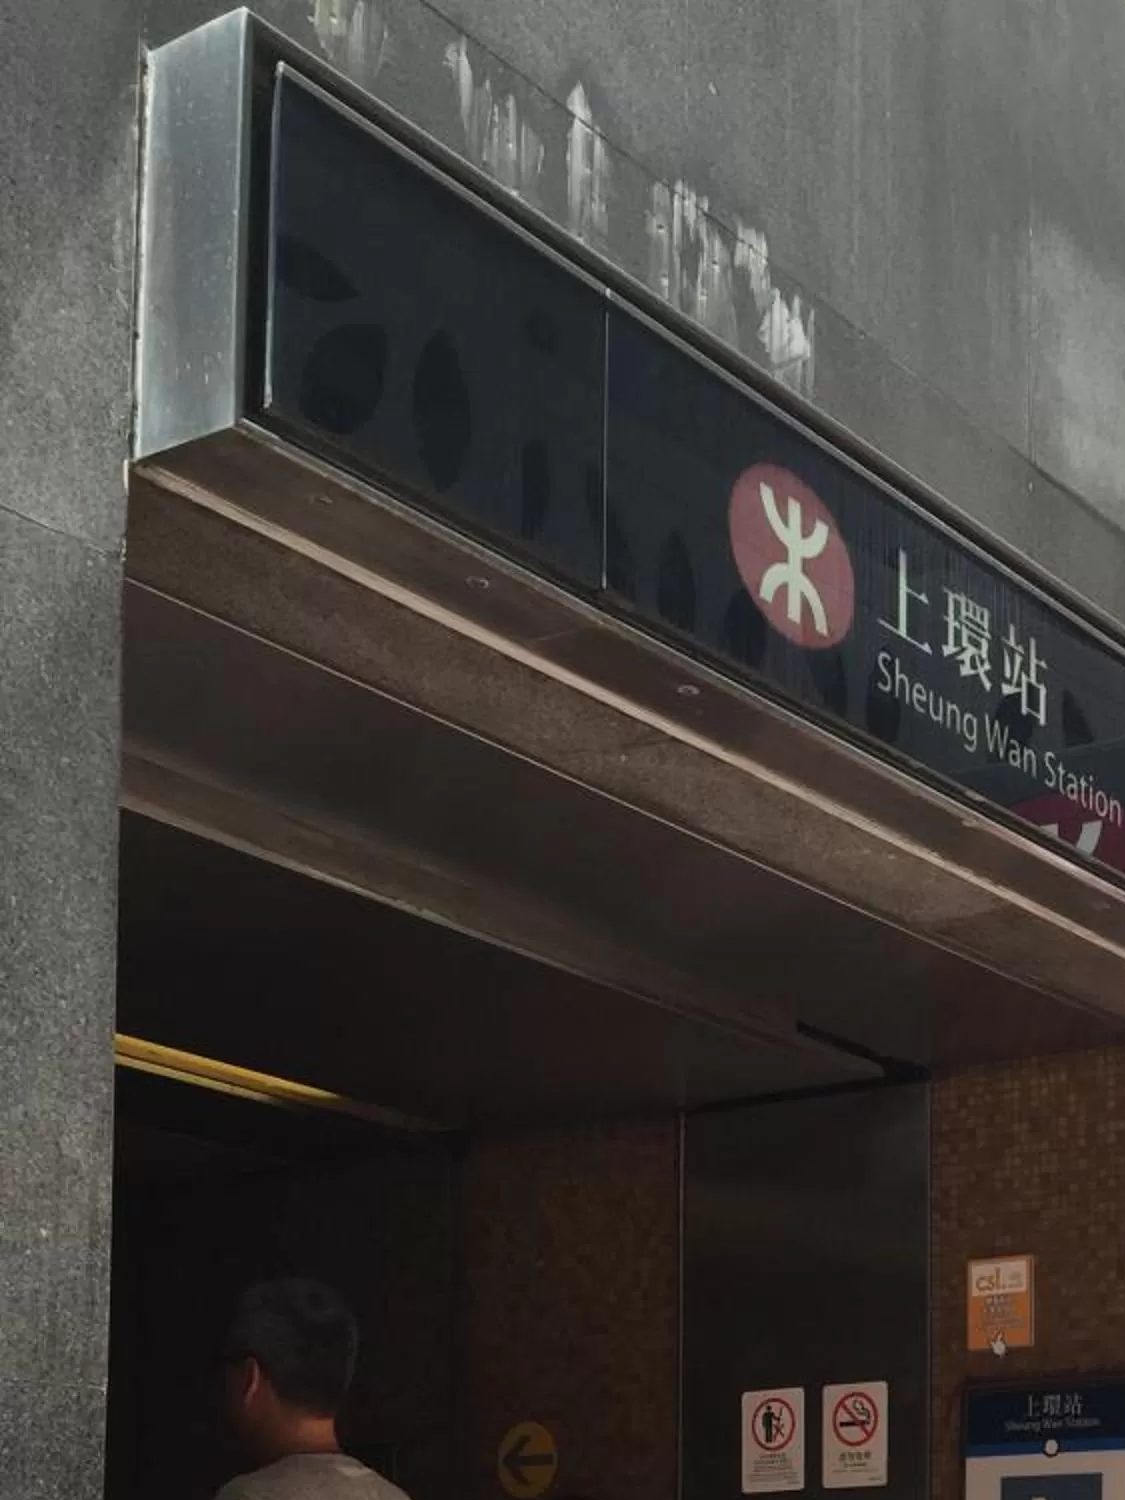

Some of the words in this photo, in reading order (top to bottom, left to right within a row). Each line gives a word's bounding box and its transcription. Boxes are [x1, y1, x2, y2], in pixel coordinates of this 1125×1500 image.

[877, 548, 1048, 726] 上環站
[877, 651, 977, 752] Sheung
[985, 713, 1037, 778] Wan
[1044, 751, 1122, 826] Station
